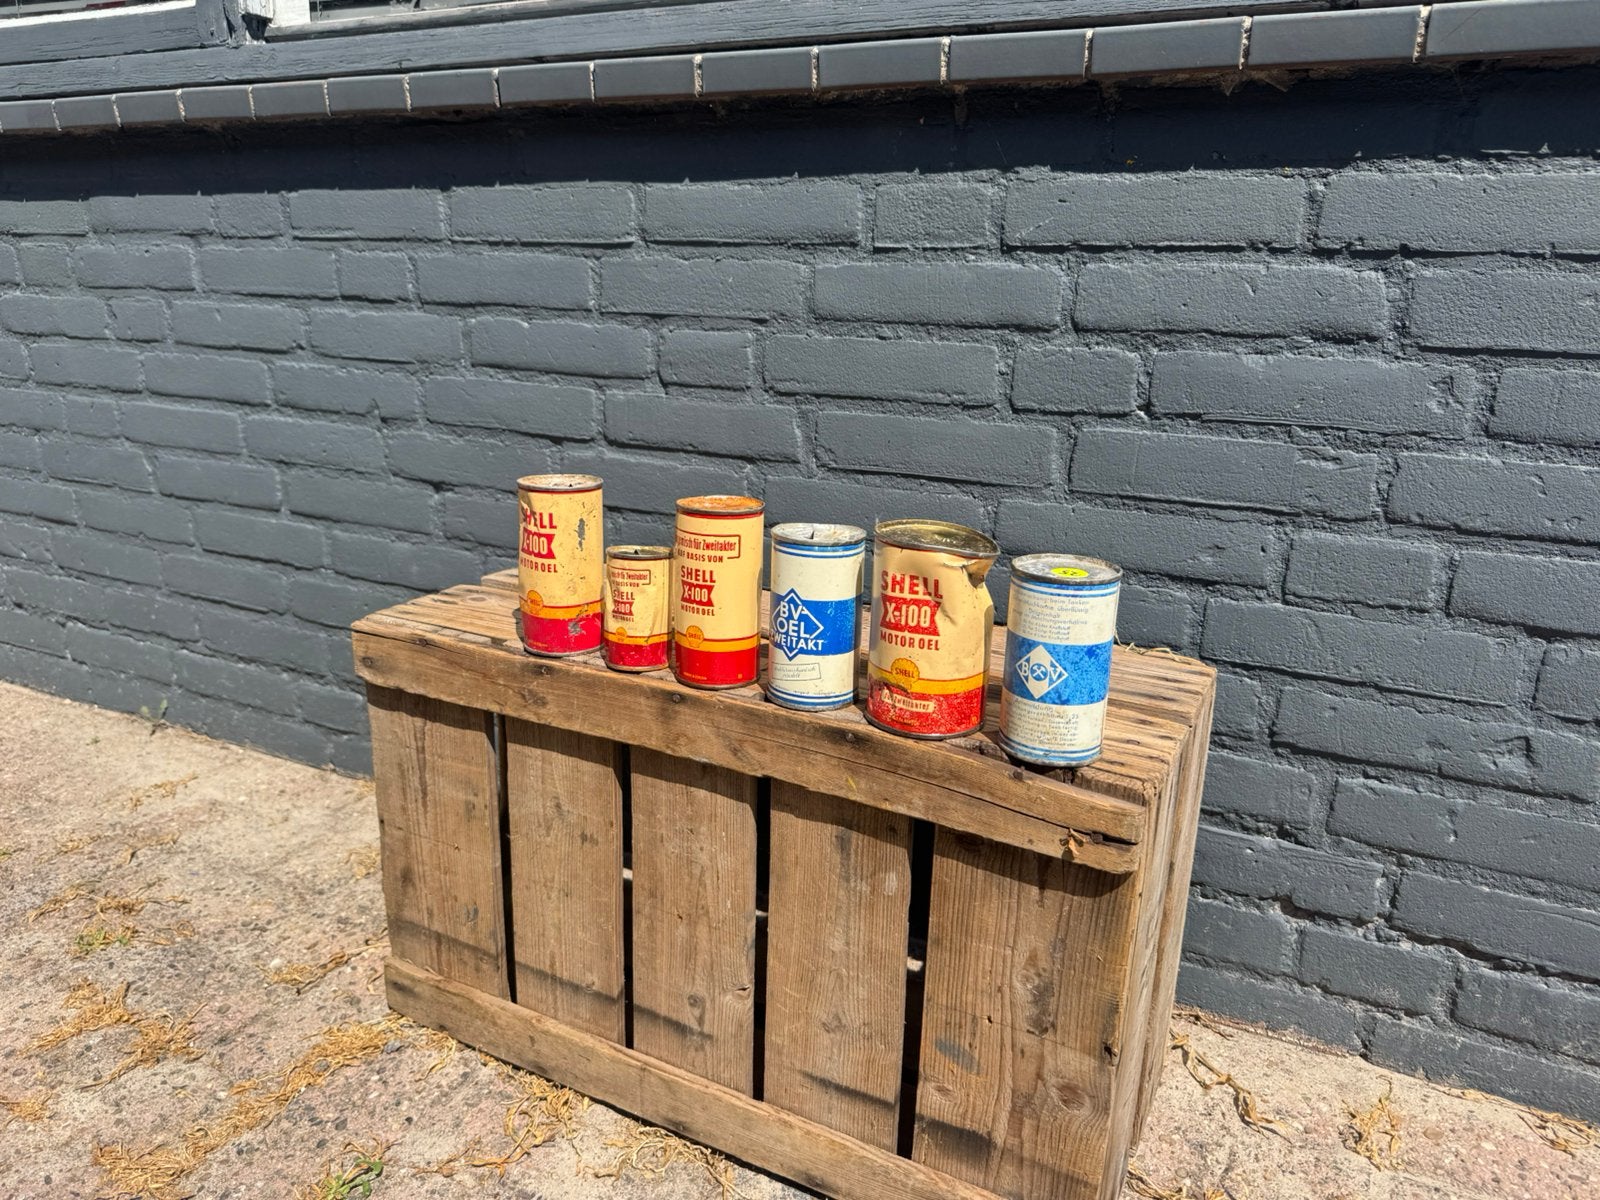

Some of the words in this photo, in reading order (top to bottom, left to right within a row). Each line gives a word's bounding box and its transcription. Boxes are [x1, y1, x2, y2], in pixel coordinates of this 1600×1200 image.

[687, 552, 706, 562] BASIS
[707, 555, 723, 563] VON
[681, 565, 716, 583] SHELL
[683, 585, 708, 602] X-100
[881, 570, 943, 599] SHELL
[885, 601, 931, 628] X-100
[776, 617, 810, 638] OEL
[894, 667, 915, 679] SHELL
[1021, 662, 1029, 676] B
[1050, 667, 1061, 681] V
